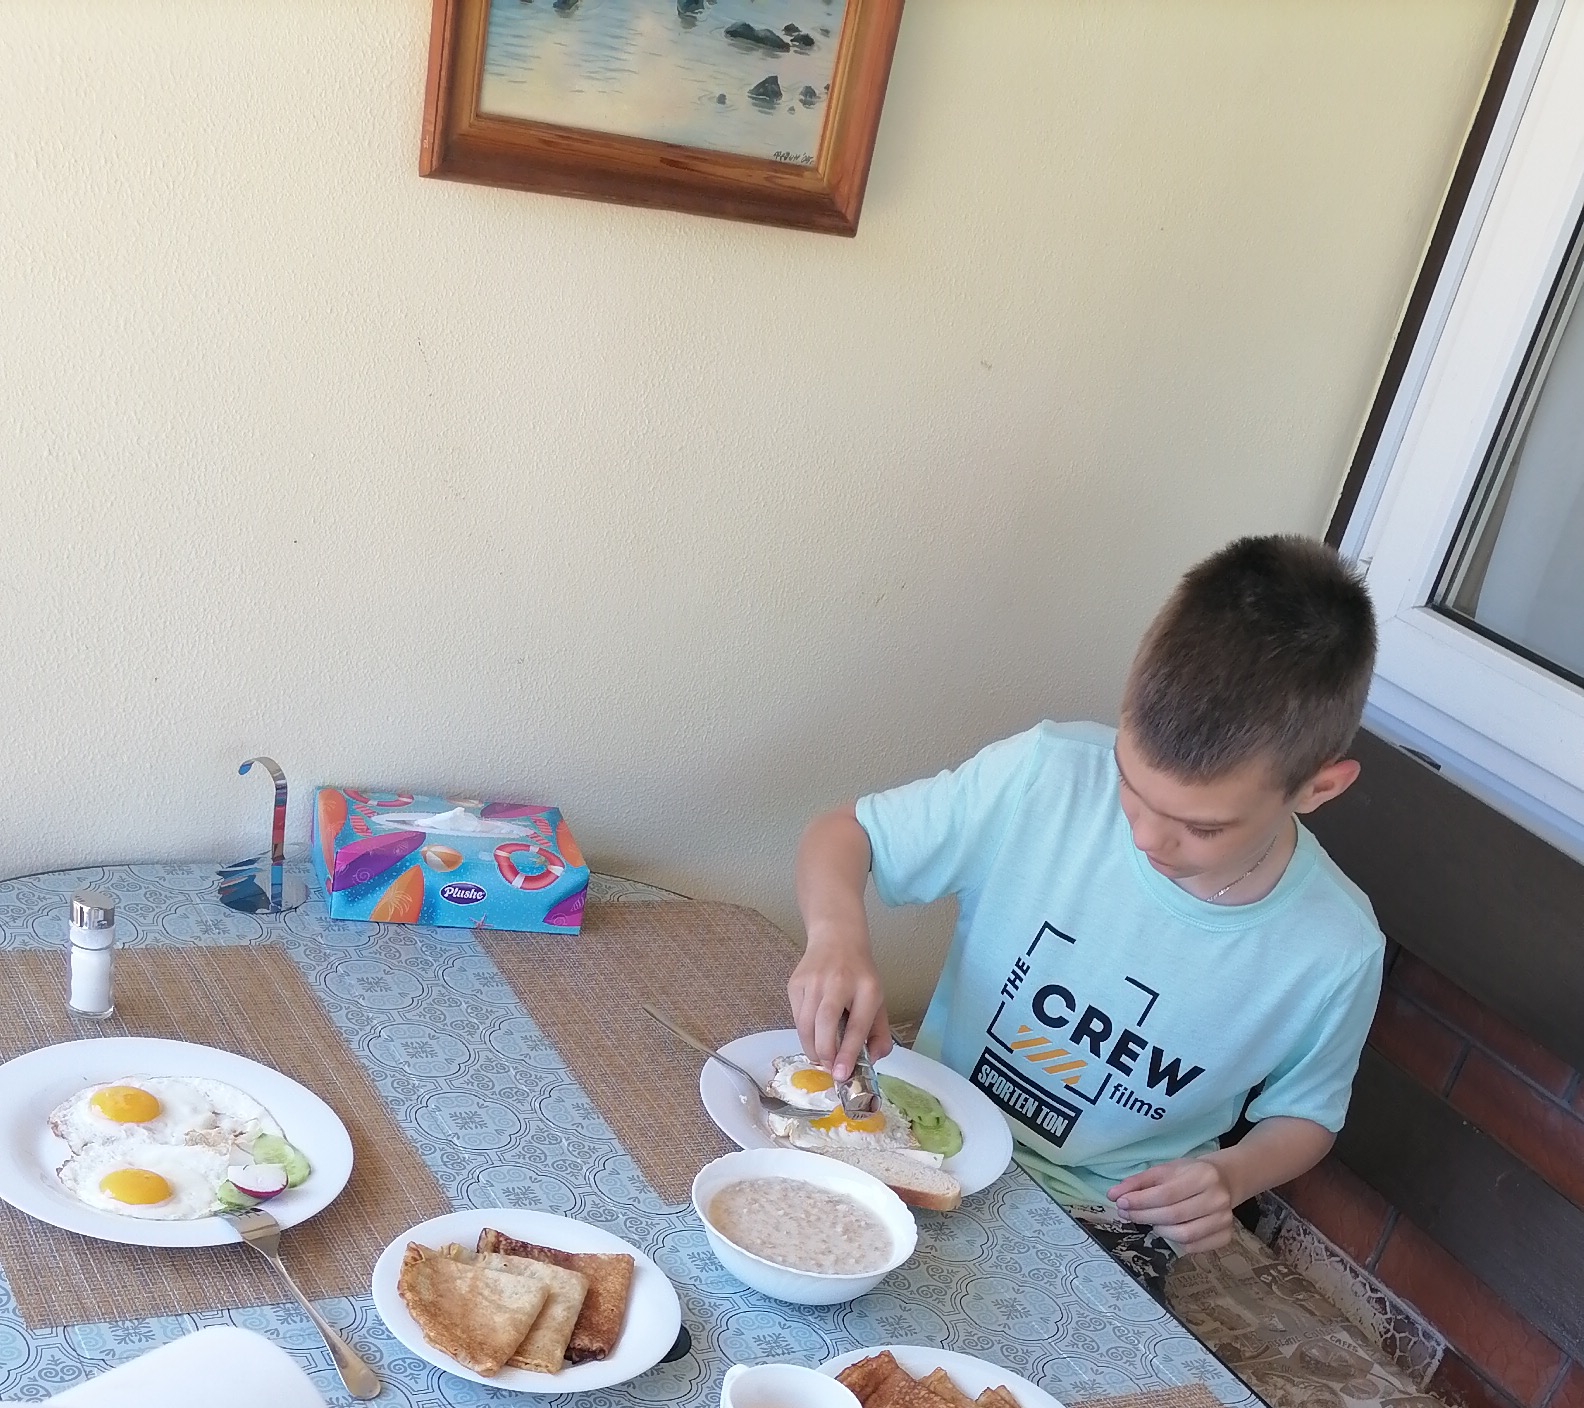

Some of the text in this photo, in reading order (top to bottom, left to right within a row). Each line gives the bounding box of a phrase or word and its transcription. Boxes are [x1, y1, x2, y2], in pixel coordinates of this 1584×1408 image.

[444, 886, 485, 900] Plushe
[1001, 956, 1031, 1000] THE
[1031, 984, 1206, 1098] CREW
[977, 1064, 1069, 1138] SPORTEN TON
[1109, 1083, 1166, 1121] films
